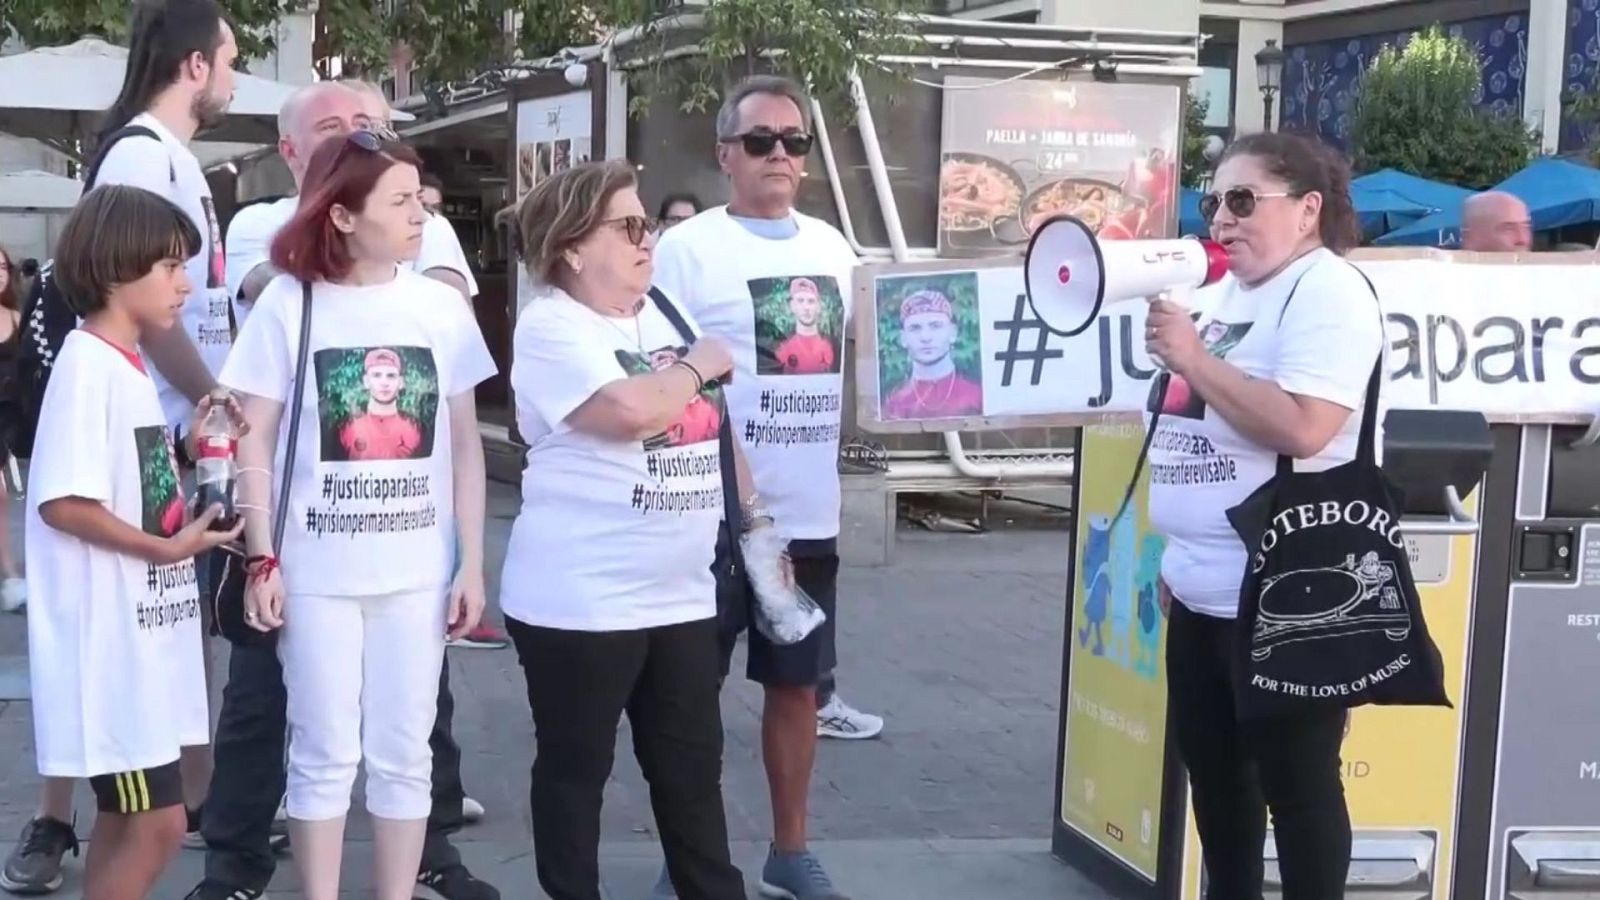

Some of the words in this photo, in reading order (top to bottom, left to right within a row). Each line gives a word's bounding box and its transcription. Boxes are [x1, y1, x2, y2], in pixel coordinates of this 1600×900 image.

[986, 129, 1026, 144] PAELLA
[322, 471, 430, 506] #justiciaparaisaac
[1251, 674, 1278, 692] FOR
[1281, 681, 1308, 697] THE
[1311, 684, 1350, 697] LOVE
[1351, 676, 1369, 693] OF
[1369, 653, 1411, 685] MUSIC
[1340, 761, 1370, 778] ID
